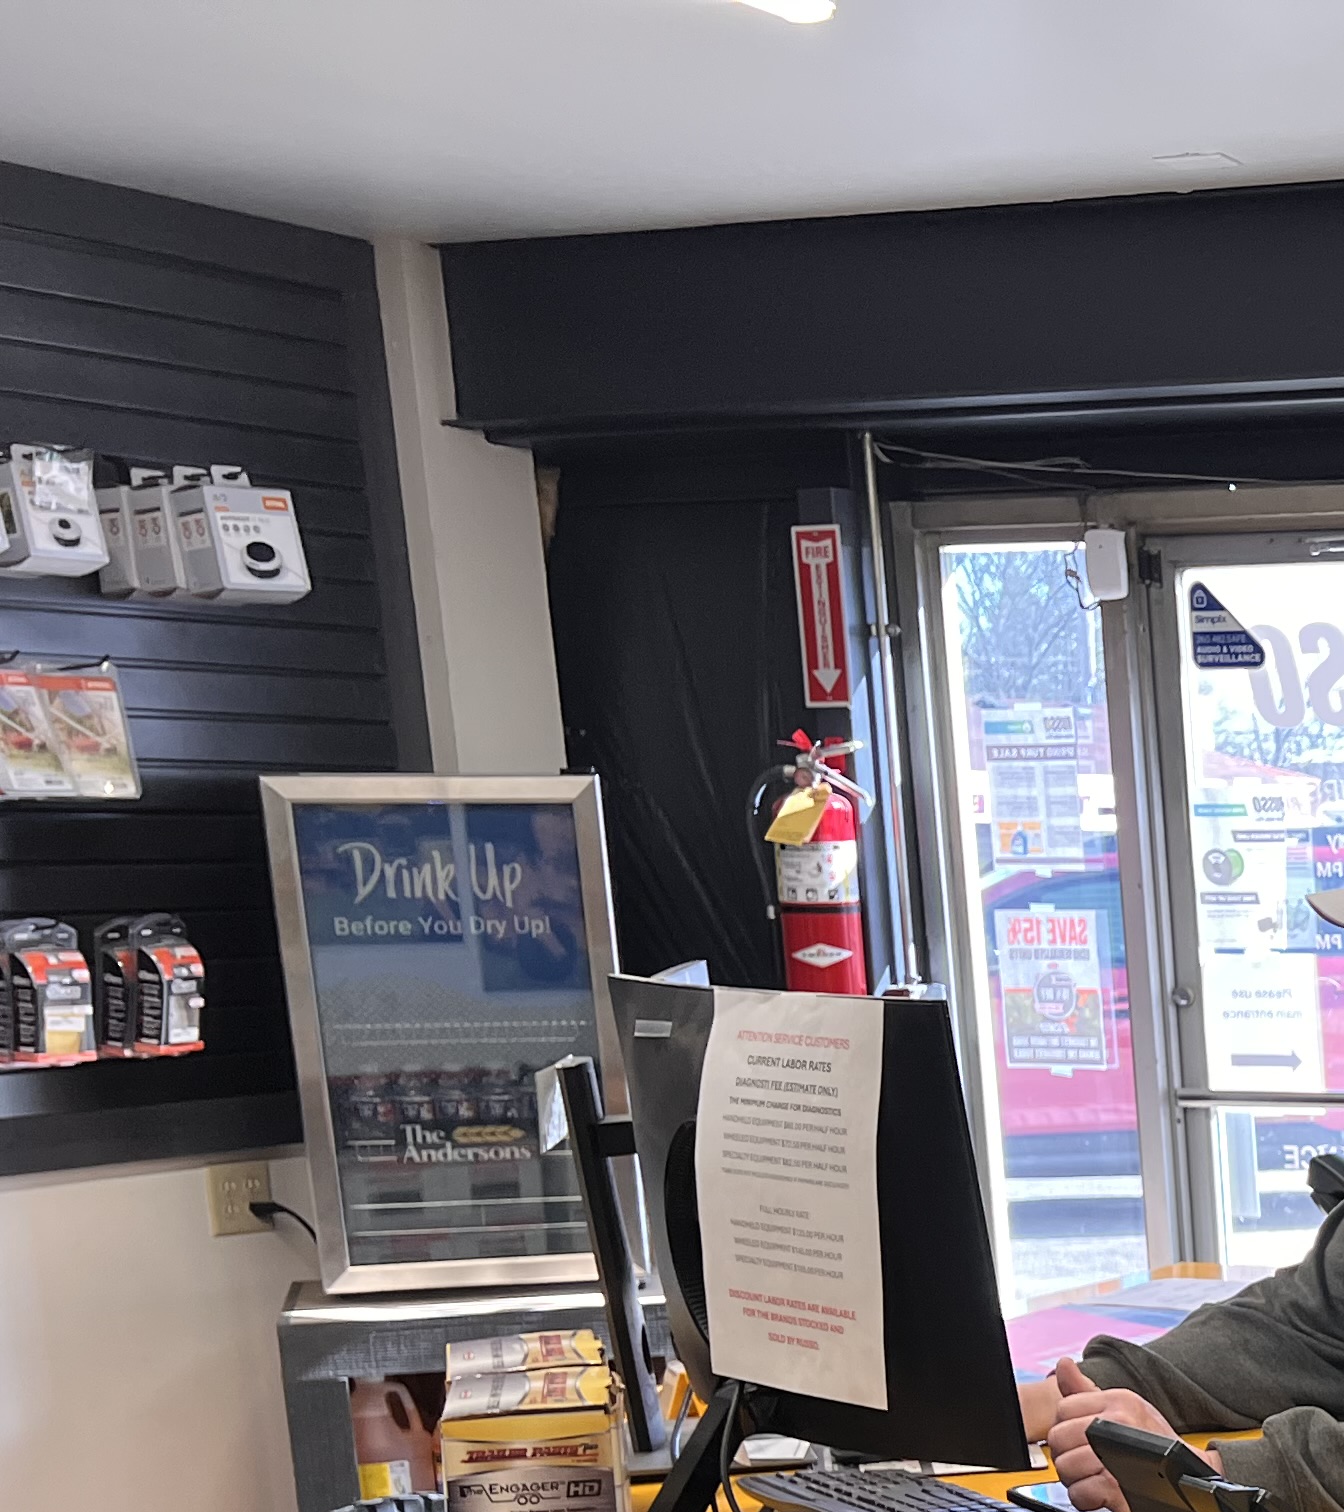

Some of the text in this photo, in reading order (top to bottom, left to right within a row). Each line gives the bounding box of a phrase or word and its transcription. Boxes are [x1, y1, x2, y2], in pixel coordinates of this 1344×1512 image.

[805, 546, 829, 559] FIRE
[337, 842, 523, 908] Drink Up
[333, 915, 551, 939] Before You Dry Up!
[747, 1055, 832, 1073] CURRENT LABOR RATES
[400, 1124, 446, 1145] The
[403, 1142, 532, 1164] Andersons
[489, 1481, 600, 1497] ENGAGER HD
